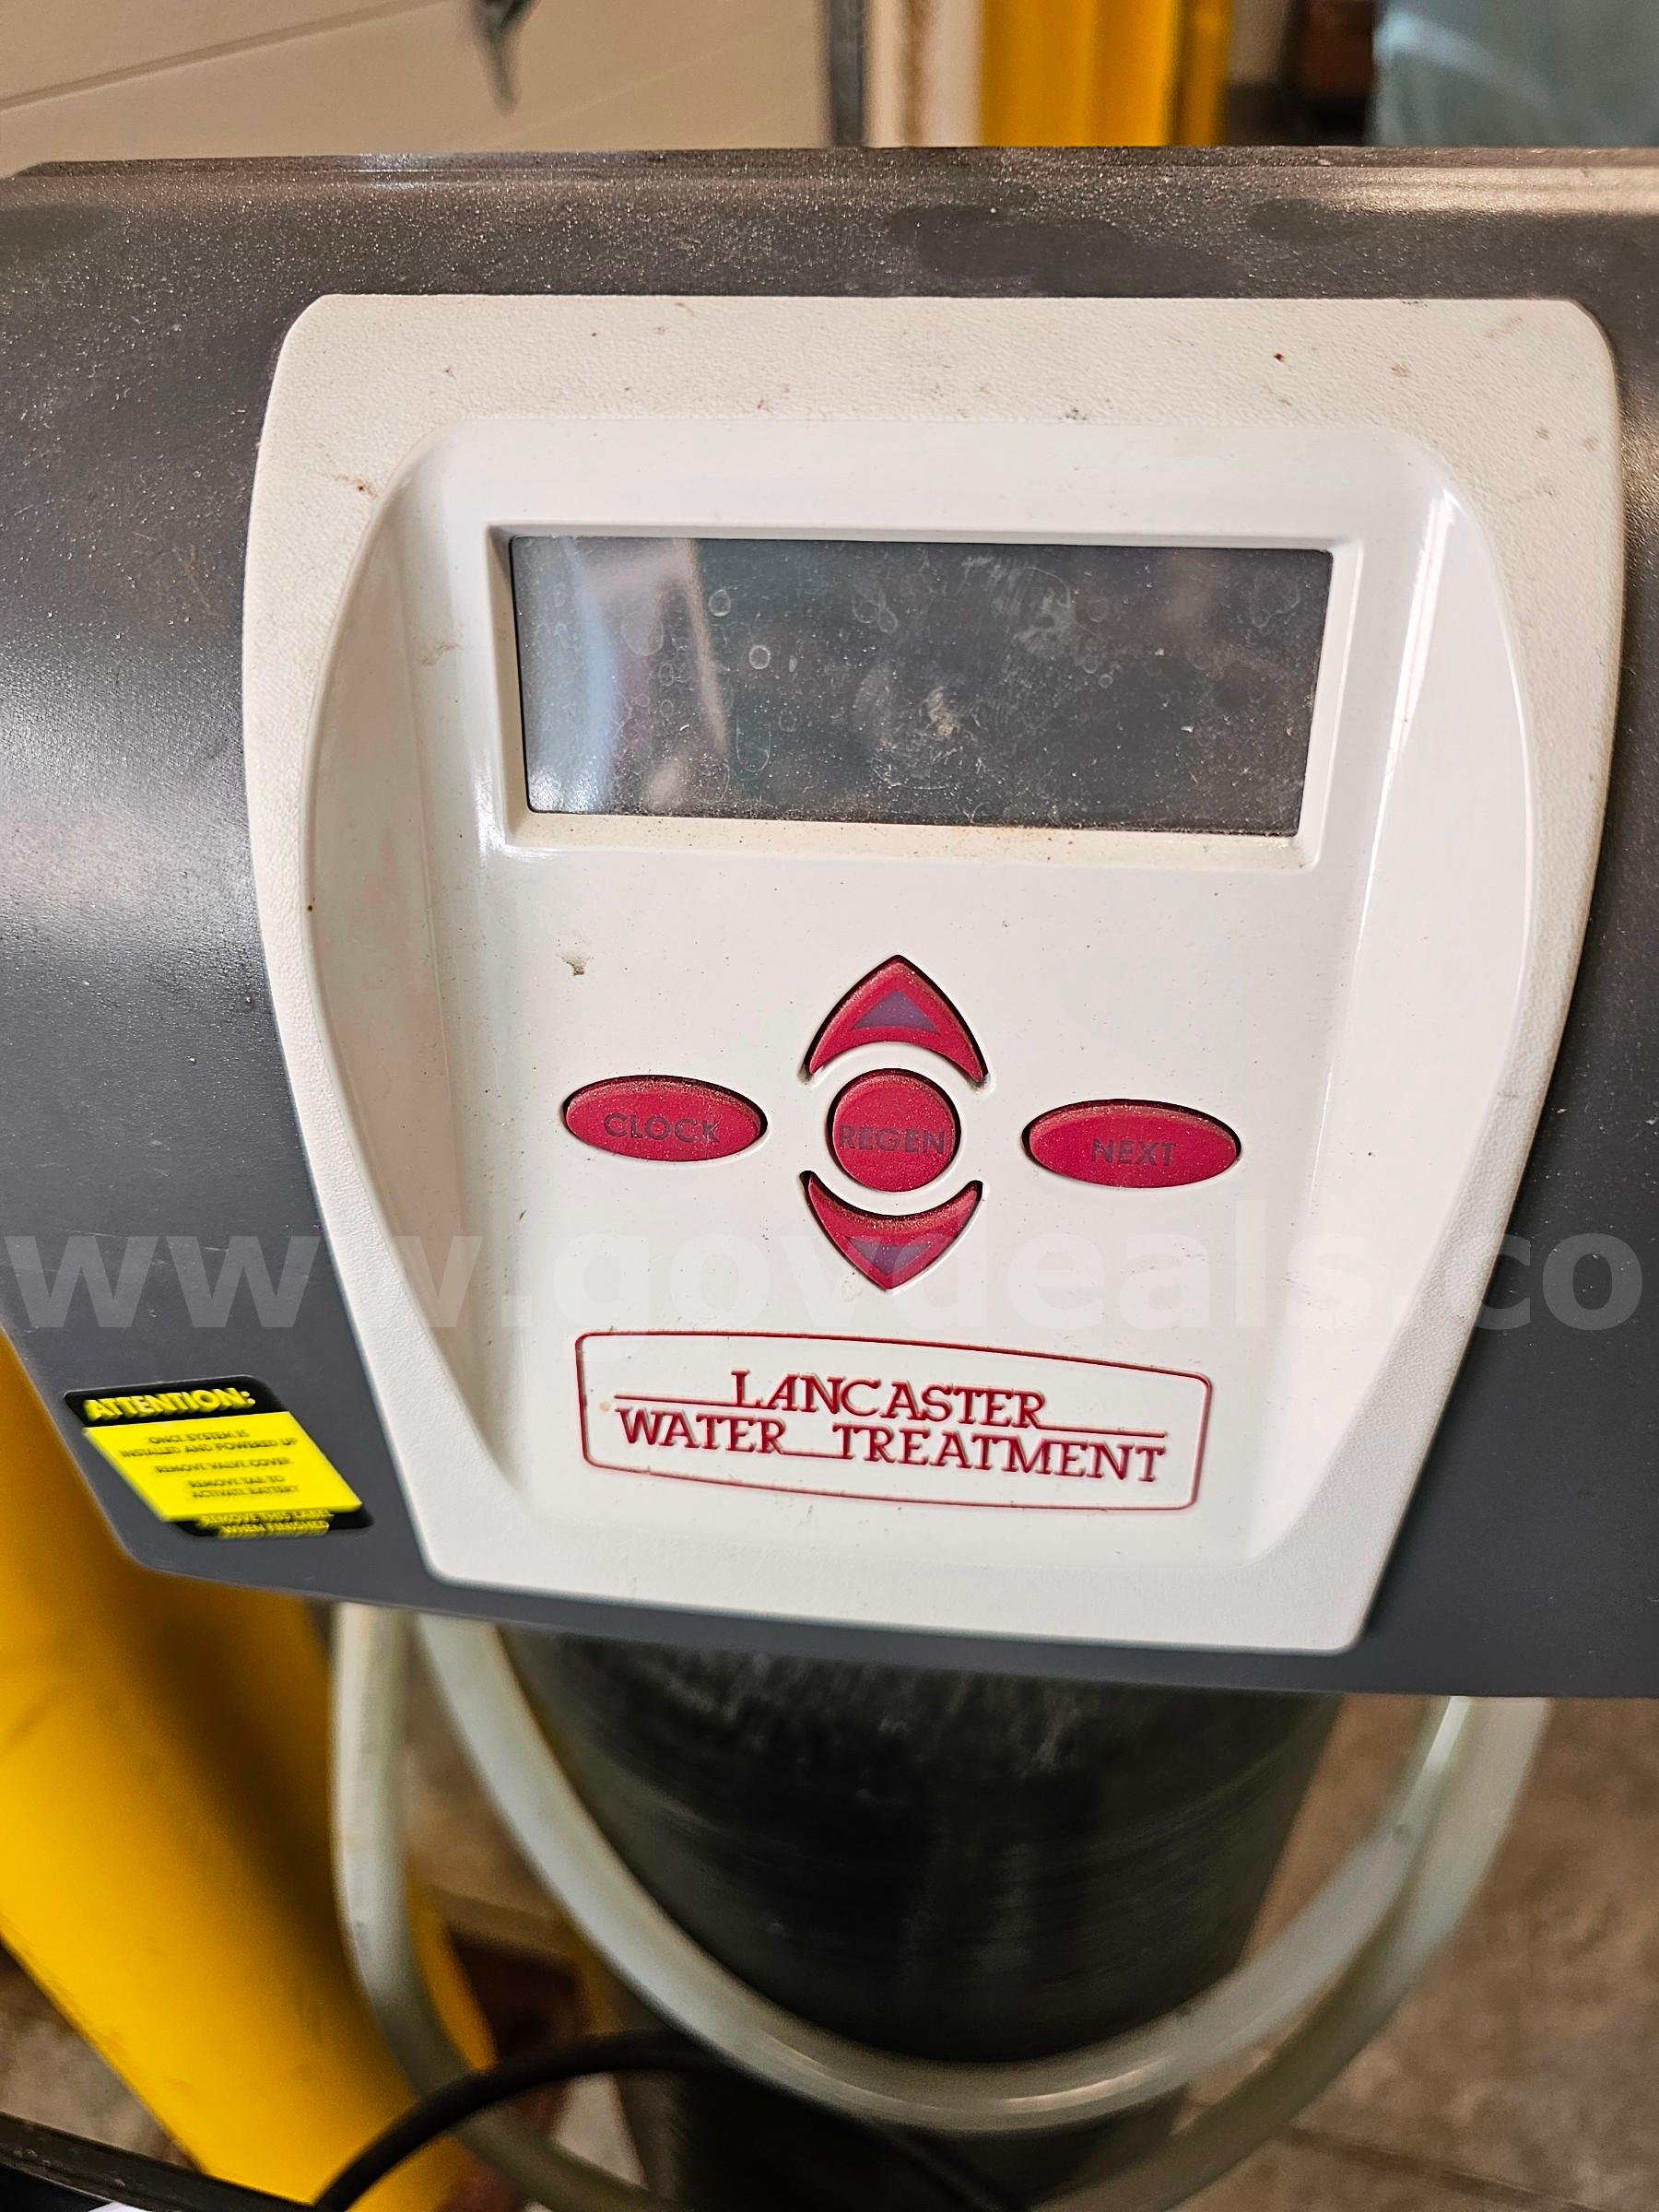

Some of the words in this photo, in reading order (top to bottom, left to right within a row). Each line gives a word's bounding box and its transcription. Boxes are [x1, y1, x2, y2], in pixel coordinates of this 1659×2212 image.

[603, 1111, 722, 1145] CLOCK
[837, 1124, 947, 1156] REGEN
[1089, 1135, 1178, 1168] NEXT
[82, 1386, 256, 1421] ATTENTION:
[729, 1369, 1045, 1430] LANCASTER
[119, 1445, 182, 1458] INSTALLED
[184, 1443, 213, 1453] AND
[214, 1440, 278, 1452] POWERED
[279, 1437, 299, 1447] UP
[184, 1430, 233, 1441] SYSTEM
[615, 1407, 788, 1453] WATER
[831, 1422, 1164, 1482] TREATMENT
[154, 1463, 206, 1474] REMOVE
[247, 1457, 292, 1467] COVER
[188, 1477, 241, 1488] REMOVE
[266, 1475, 286, 1483] TO
[218, 1524, 265, 1537] WHEN
[265, 1521, 329, 1535] FINISHED
[260, 1511, 290, 1523] THIS
